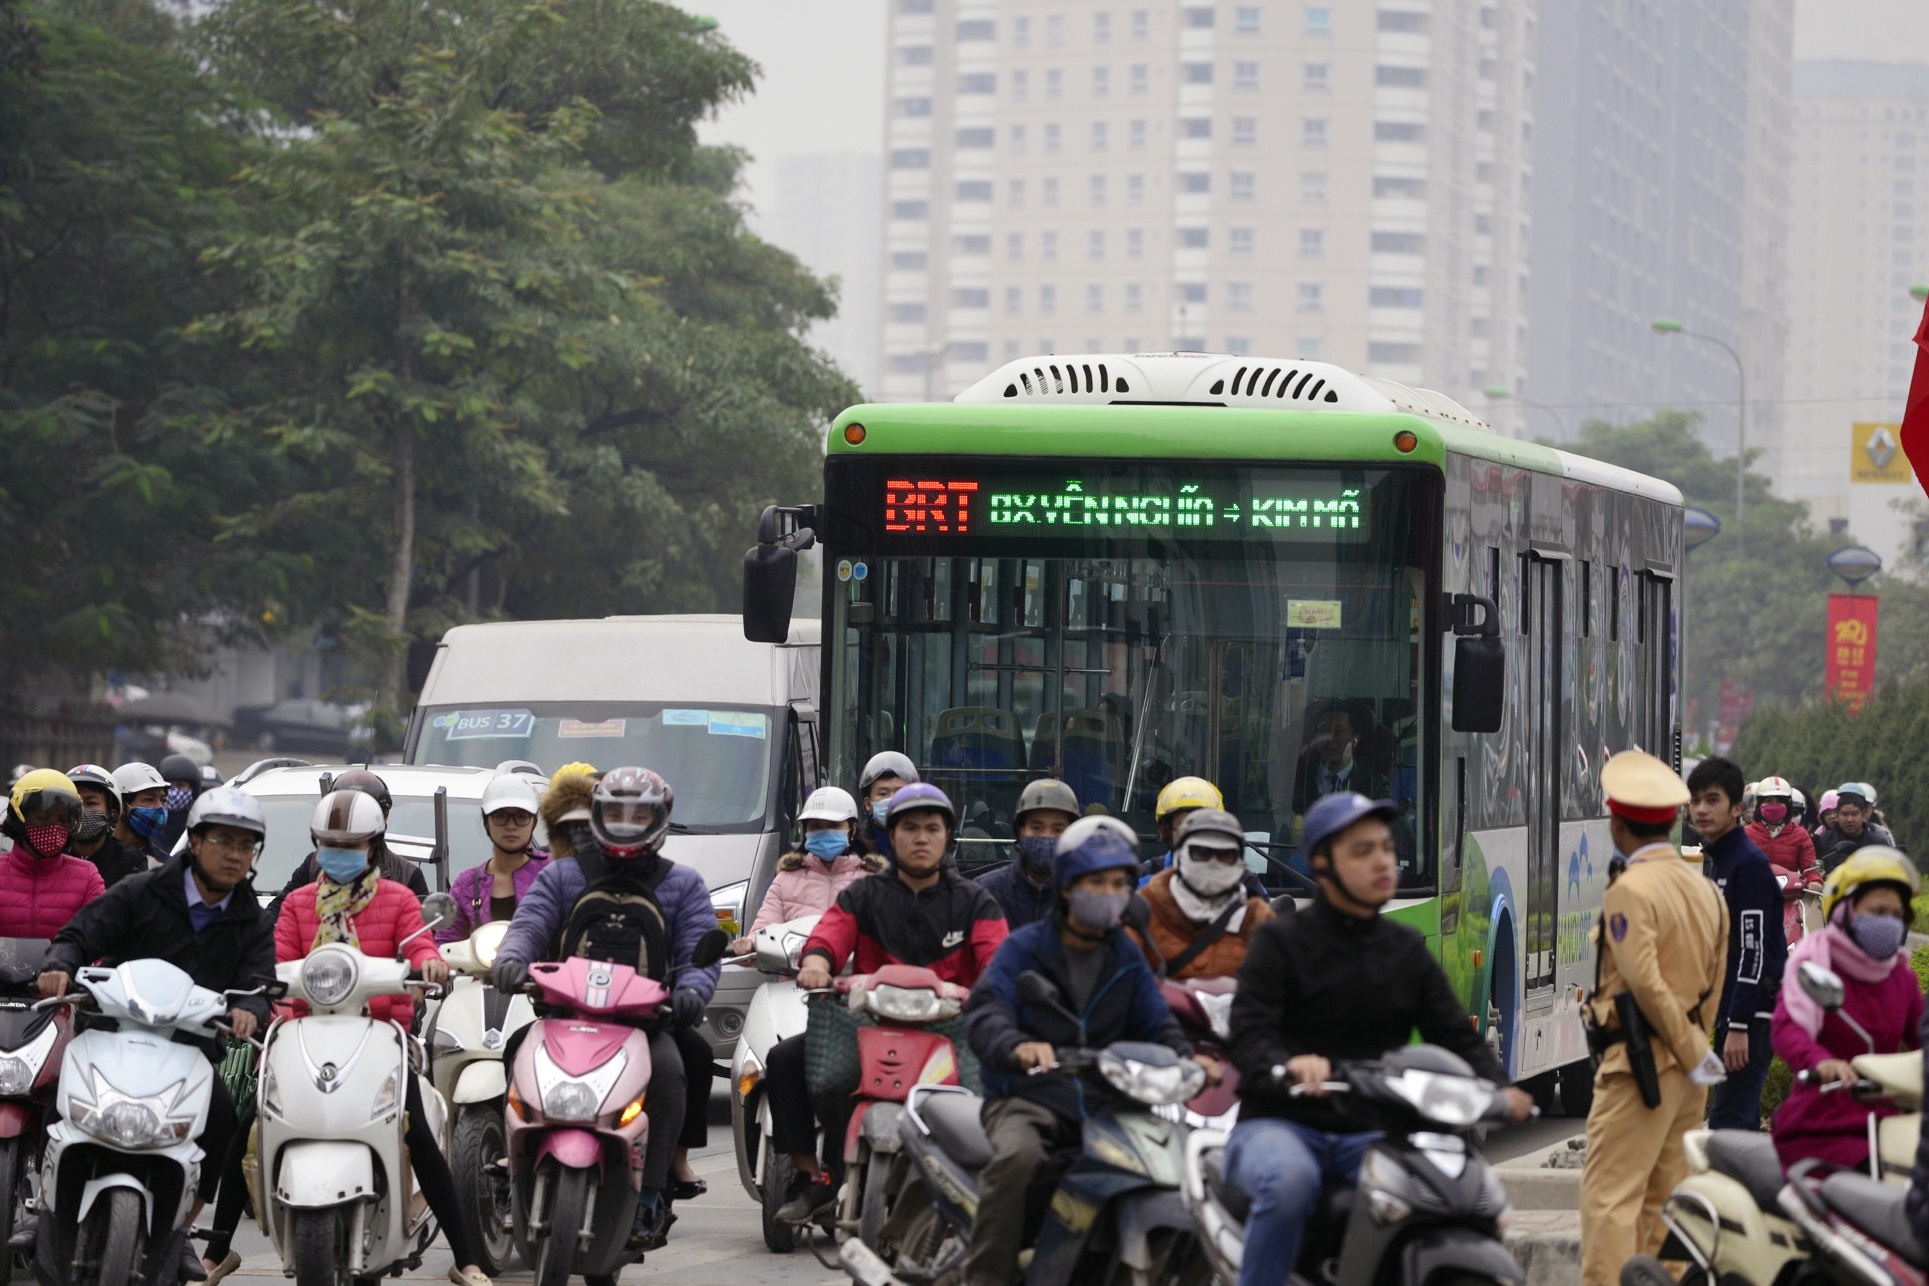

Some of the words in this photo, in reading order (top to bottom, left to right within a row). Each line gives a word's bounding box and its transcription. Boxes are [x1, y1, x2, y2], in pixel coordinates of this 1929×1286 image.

[886, 480, 978, 531] BRT
[1252, 498, 1308, 528] KIM
[1313, 489, 1360, 529] MÃ
[457, 716, 491, 731] BUS
[496, 713, 528, 729] 37
